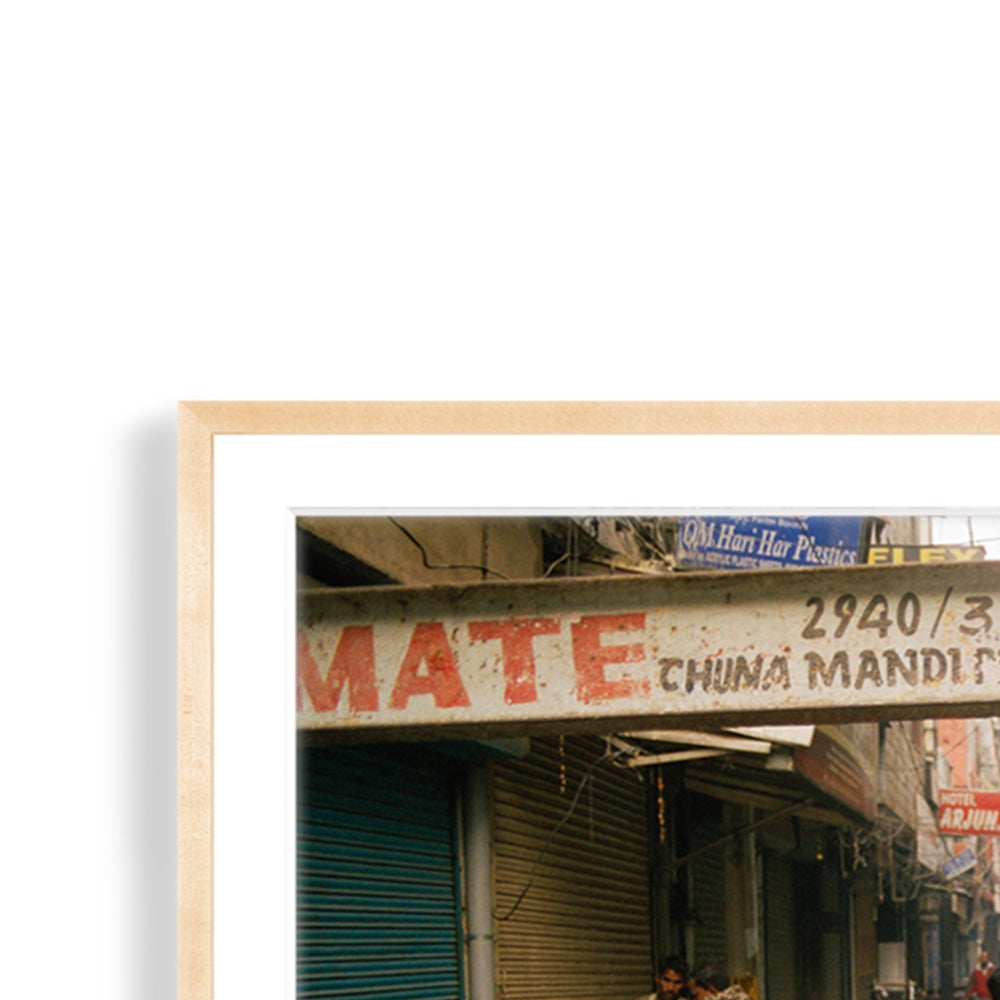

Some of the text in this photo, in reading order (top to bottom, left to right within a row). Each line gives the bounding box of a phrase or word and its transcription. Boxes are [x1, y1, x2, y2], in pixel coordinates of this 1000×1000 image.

[717, 524, 757, 553] Hari
[757, 529, 792, 559] Har
[793, 534, 857, 565] Plastics
[297, 612, 651, 713] MATE
[658, 653, 793, 694] CHUNA
[803, 648, 962, 690] MANDI
[940, 792, 977, 807] HOTEL
[940, 807, 999, 831] ARJUN
